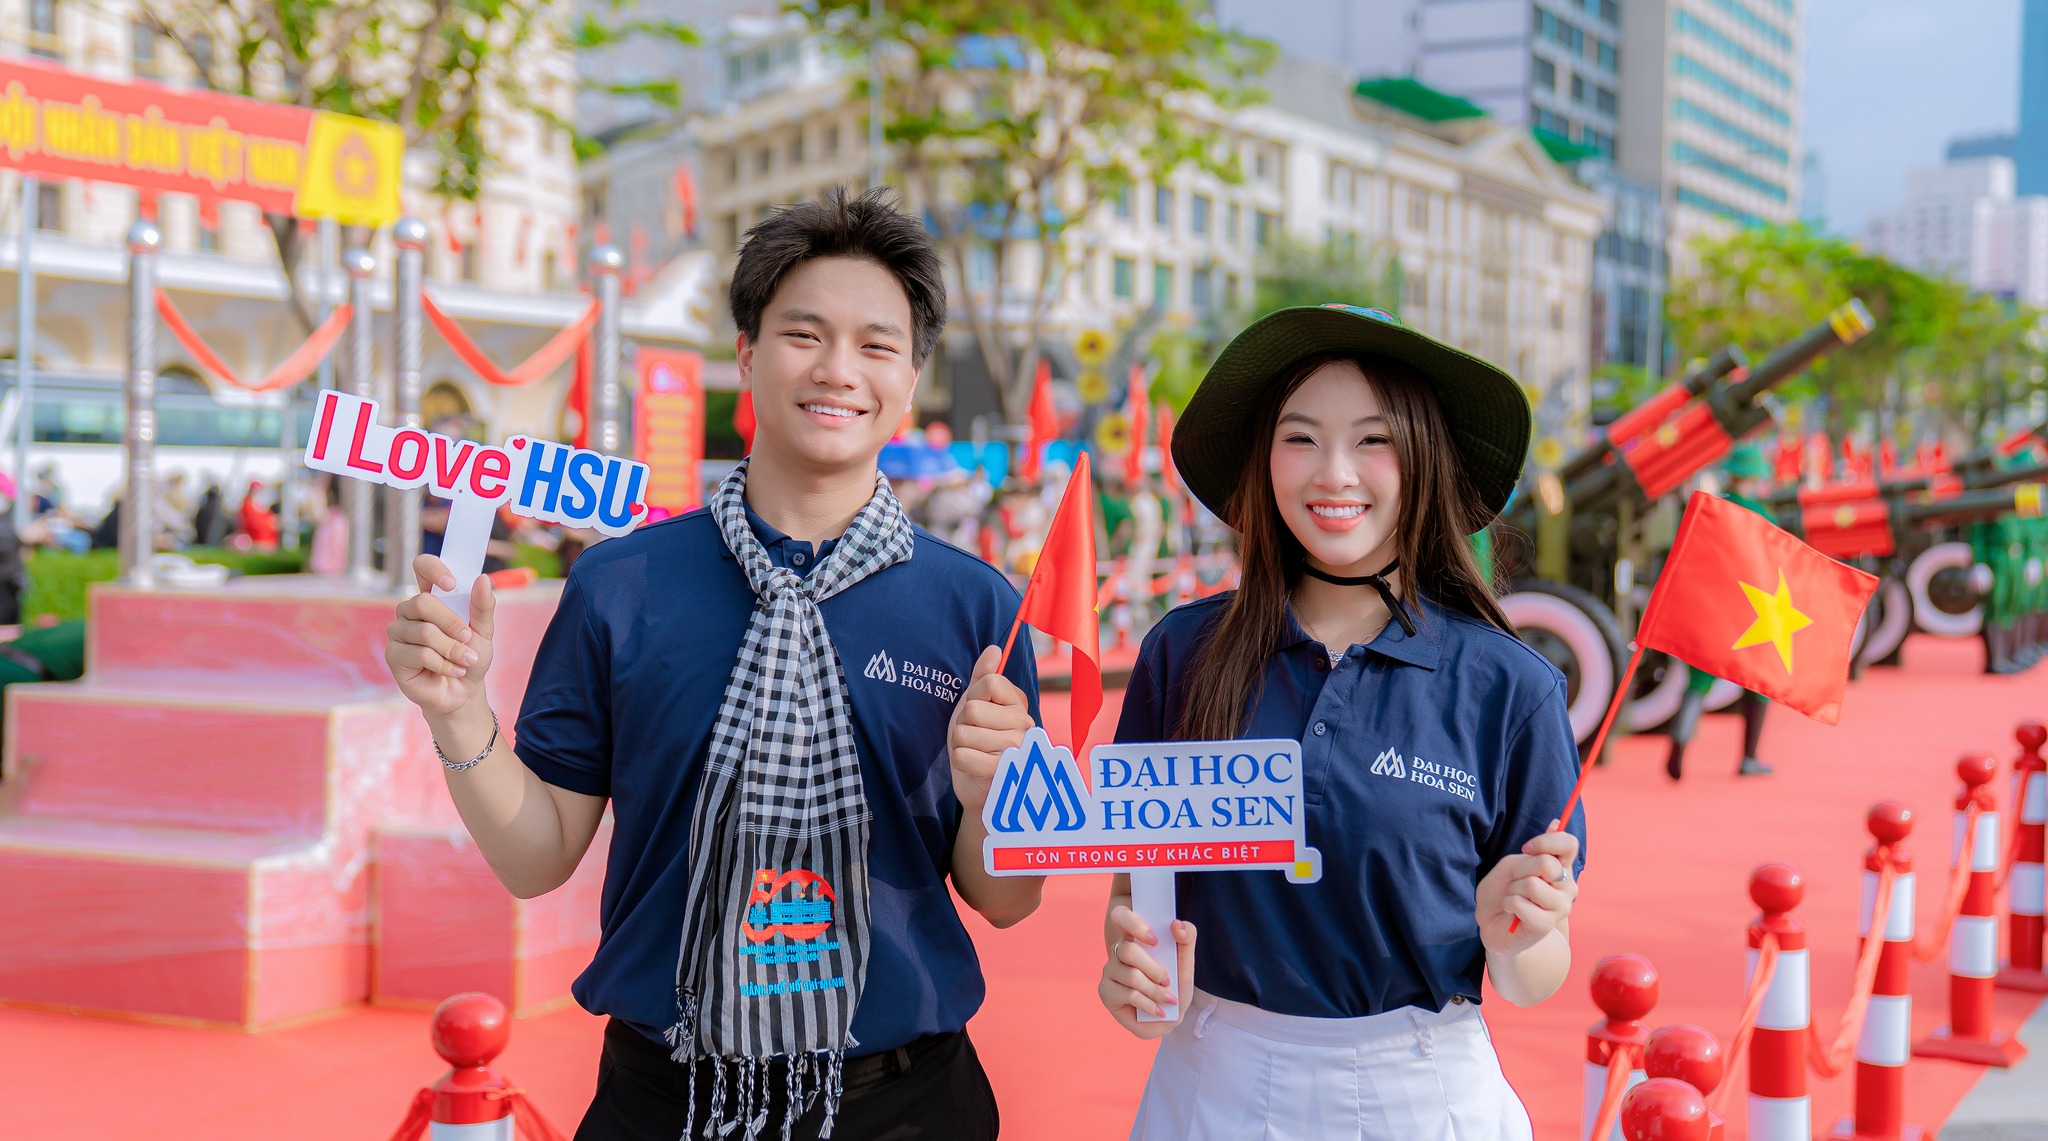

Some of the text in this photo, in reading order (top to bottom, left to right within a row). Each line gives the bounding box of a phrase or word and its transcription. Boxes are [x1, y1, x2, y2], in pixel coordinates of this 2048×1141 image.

[312, 394, 645, 529] I Love HSU
[900, 674, 958, 704] HOA SEN
[902, 660, 962, 690] ĐẠI HỌC
[1099, 752, 1293, 791] ĐẠI HỌC
[1410, 769, 1475, 802] HOA SEN
[1412, 755, 1477, 787] ĐẠI HỌC
[1101, 794, 1296, 831] HOA SEN
[1025, 844, 1260, 865] TÔN TRỌNG SỰ KHÁC BIỆT
